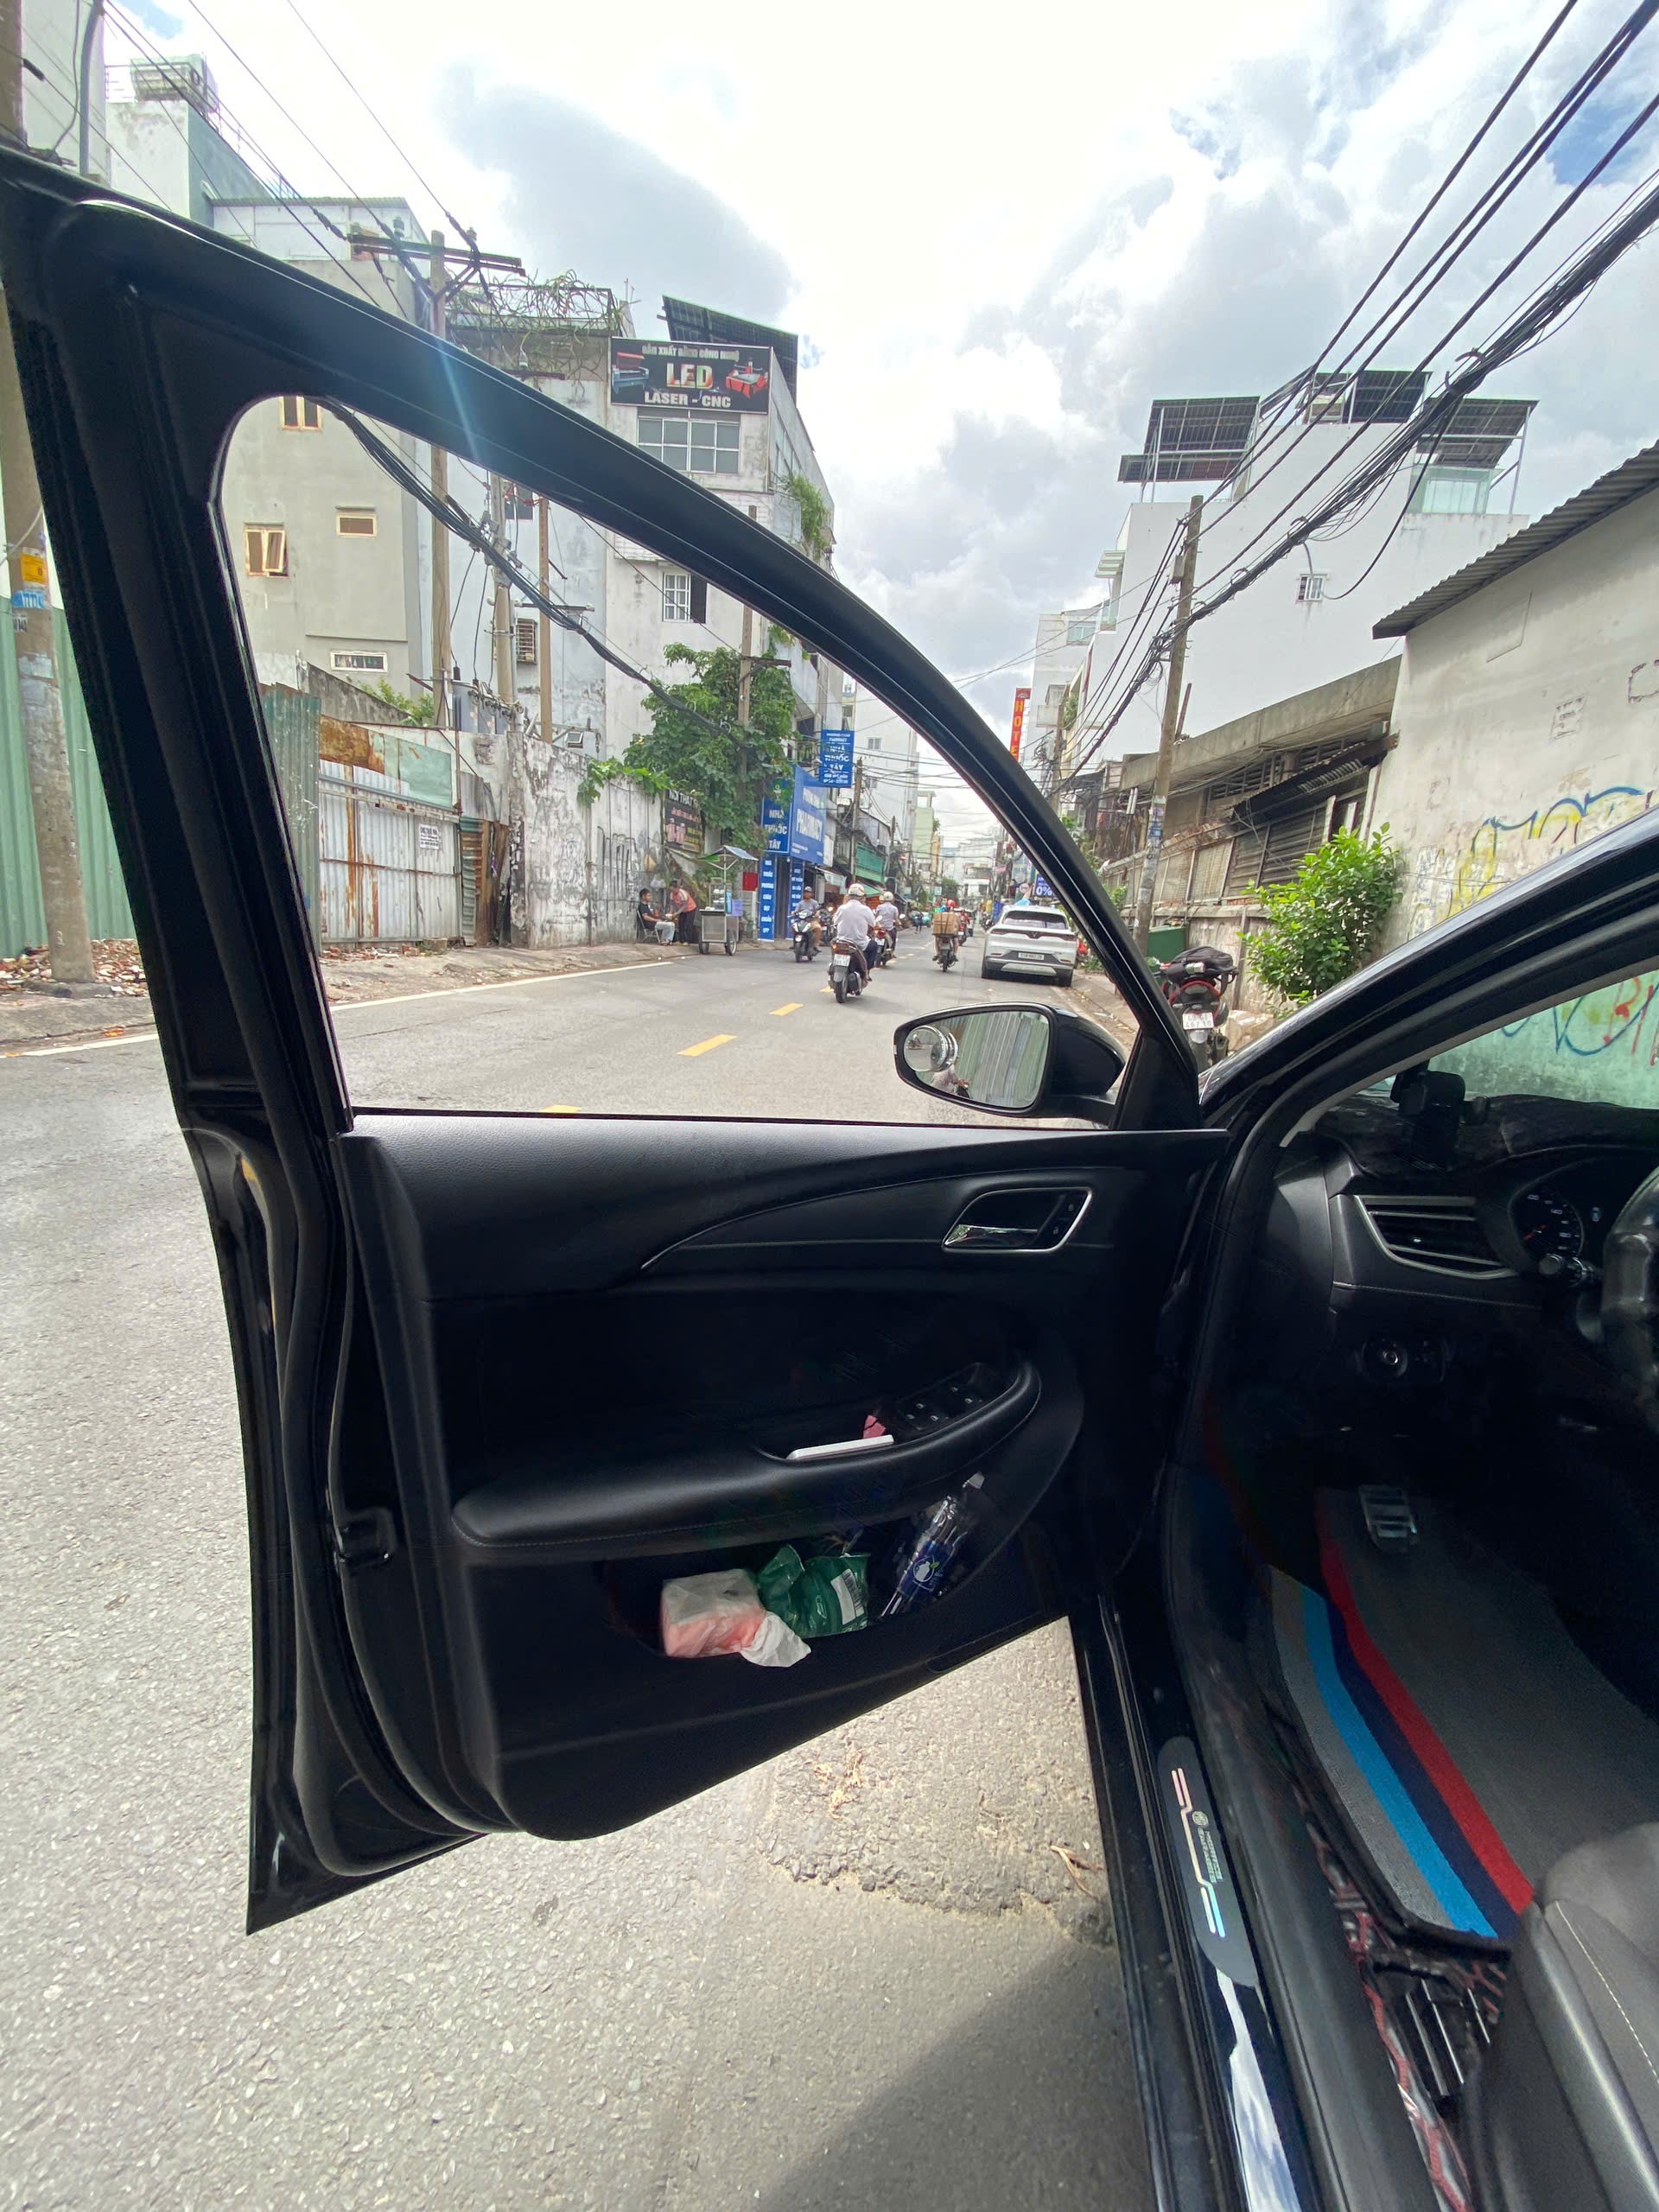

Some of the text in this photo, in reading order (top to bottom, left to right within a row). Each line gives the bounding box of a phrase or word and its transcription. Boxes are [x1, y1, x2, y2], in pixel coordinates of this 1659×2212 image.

[667, 363, 713, 389] LED
[645, 391, 689, 405] LASER
[702, 395, 731, 408] CNC
[1010, 700, 1025, 759] HOTE
[768, 838, 782, 850] TÂY
[1036, 886, 1052, 897] 0%
